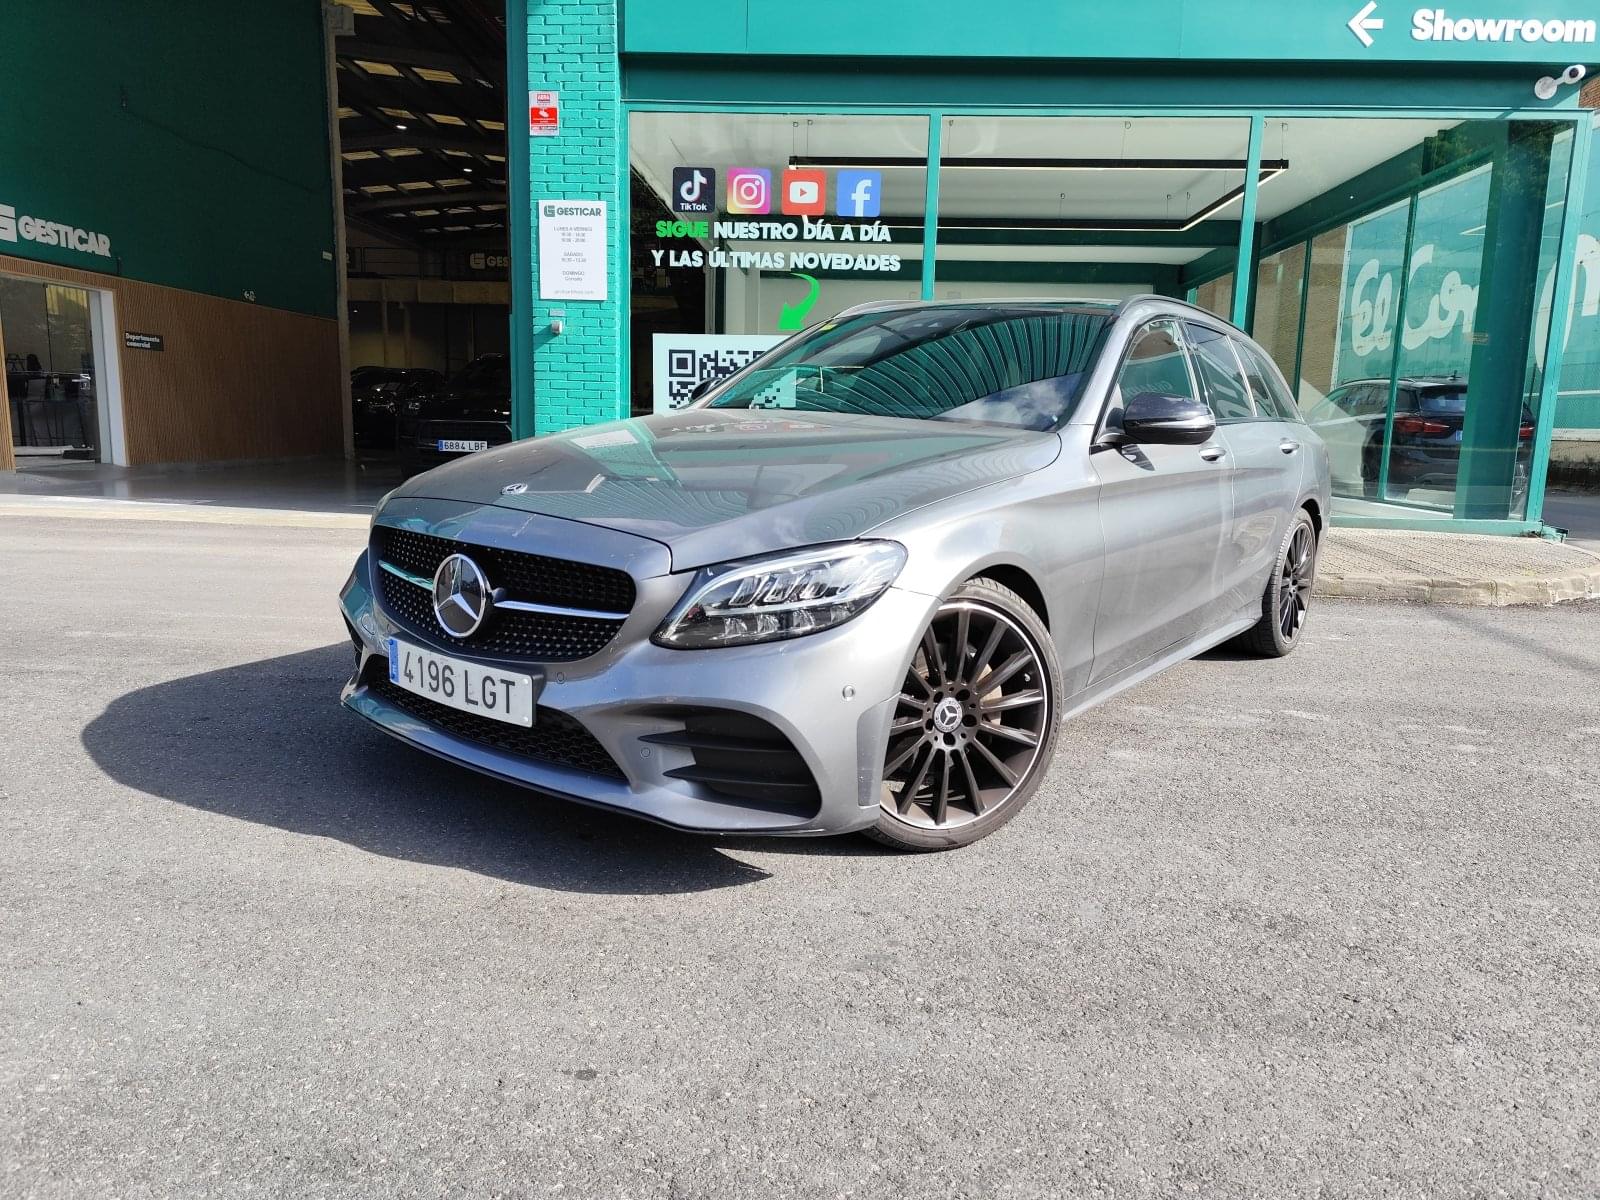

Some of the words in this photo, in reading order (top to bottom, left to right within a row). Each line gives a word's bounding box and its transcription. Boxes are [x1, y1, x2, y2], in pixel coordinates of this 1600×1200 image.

[1411, 8, 1596, 42] Showroom
[556, 207, 601, 216] GESTICAR
[680, 203, 708, 211] TikTok
[18, 215, 111, 257] GESTICAR
[655, 220, 709, 239] SIGUE
[713, 221, 799, 240] NUESTRO
[803, 219, 835, 240] DÍA
[839, 224, 855, 241] A
[860, 221, 892, 242] DÍA
[650, 249, 665, 267] Y
[669, 250, 704, 267] LAS
[708, 247, 785, 269] ÚLTIMAS
[789, 251, 901, 272] NOVEDADES
[444, 441, 466, 450] 6884
[468, 442, 486, 451] LBF
[404, 651, 455, 698] 4196
[464, 669, 516, 714] LGT
